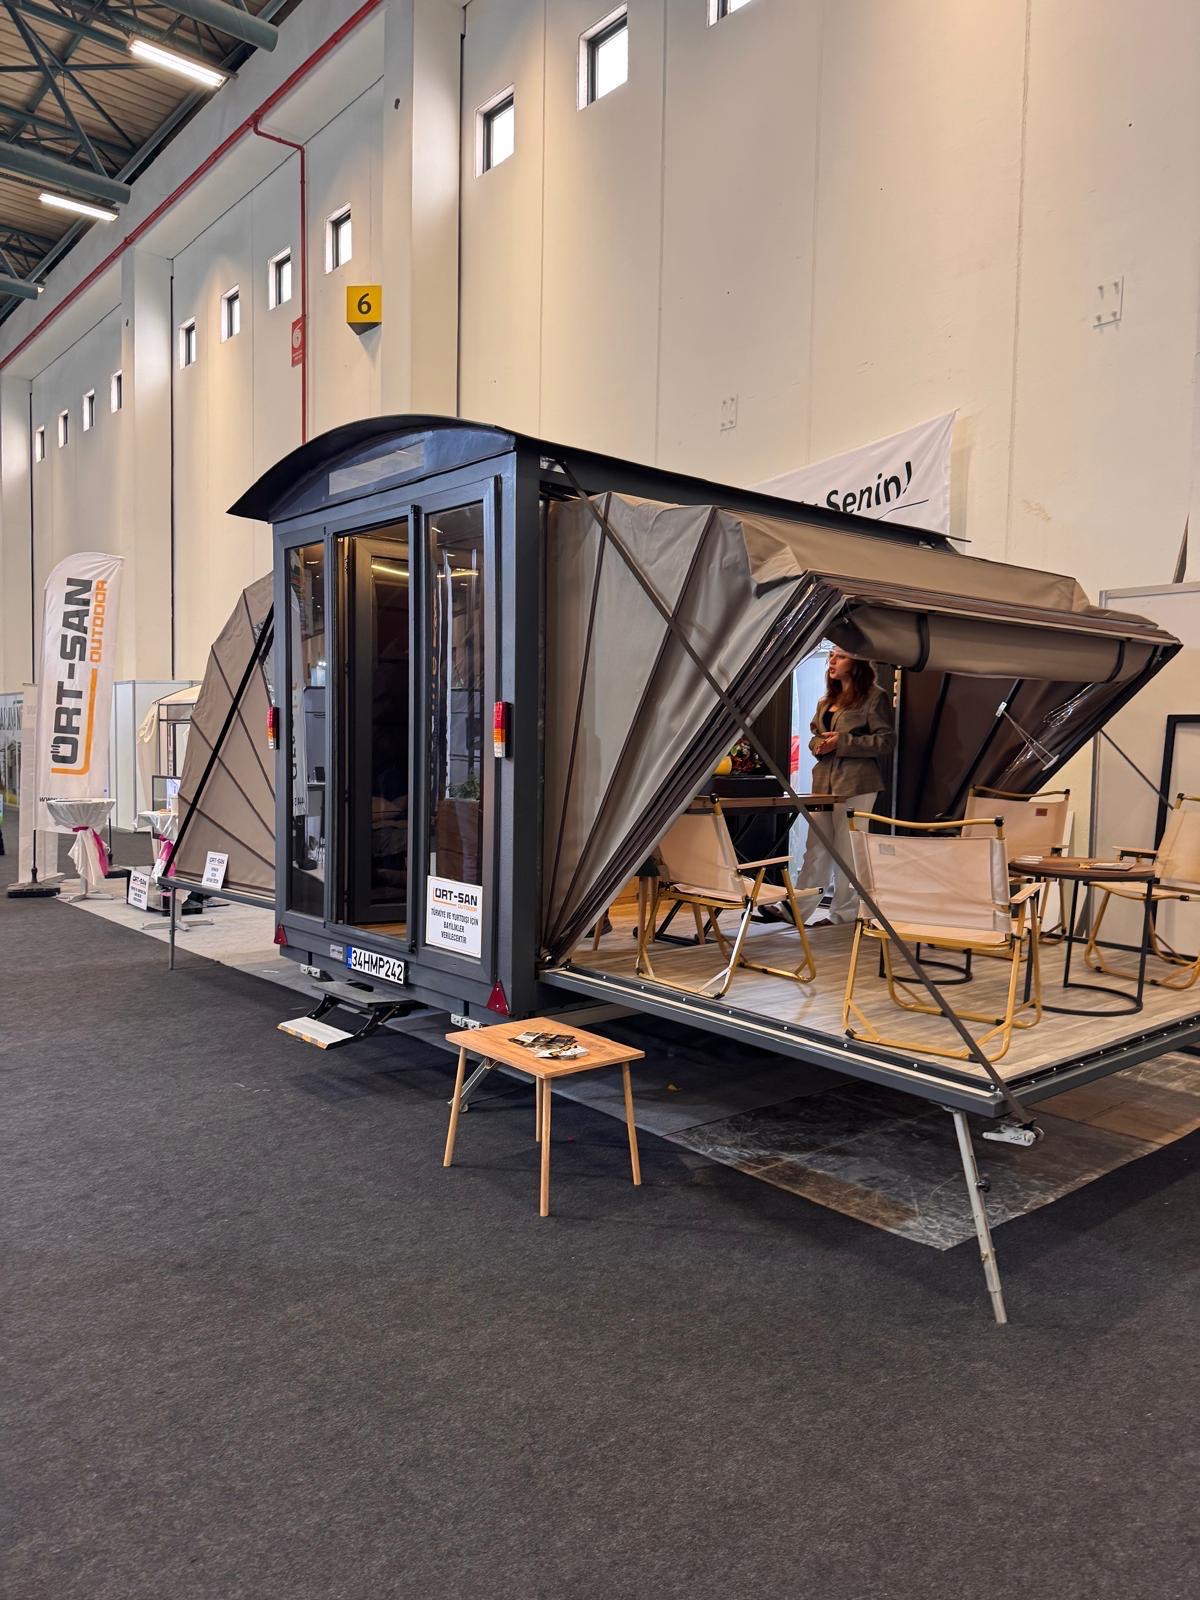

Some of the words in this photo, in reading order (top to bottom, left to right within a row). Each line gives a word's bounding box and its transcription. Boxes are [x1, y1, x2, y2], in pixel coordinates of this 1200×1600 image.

[357, 293, 372, 315] 6
[90, 579, 108, 664] OUTDOOR
[446, 911, 452, 920] VE
